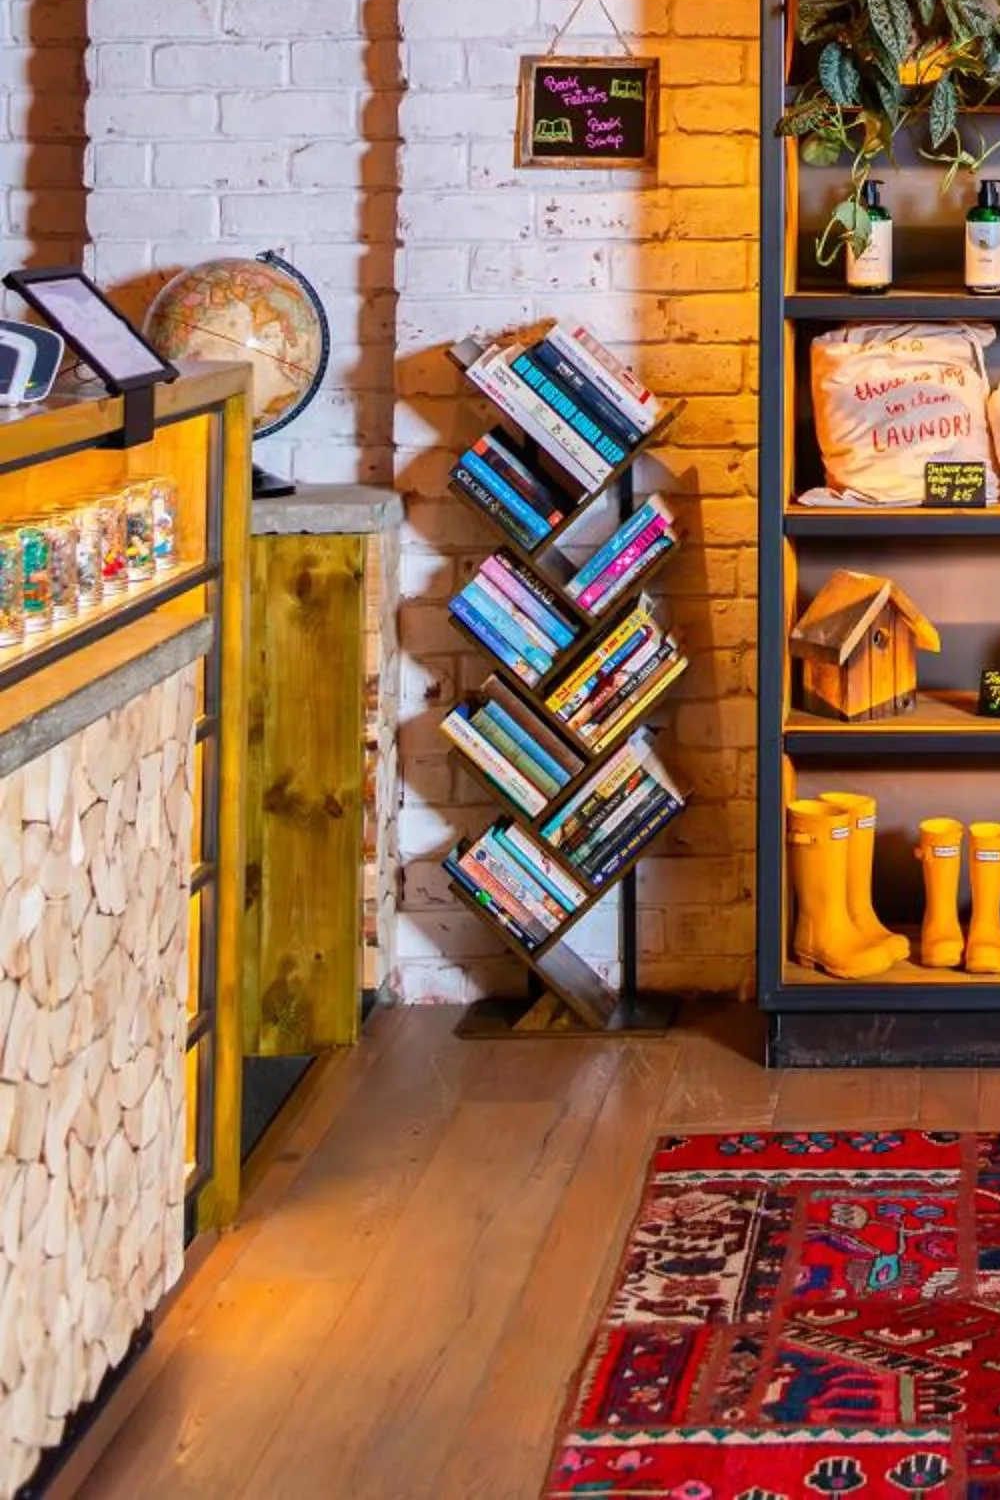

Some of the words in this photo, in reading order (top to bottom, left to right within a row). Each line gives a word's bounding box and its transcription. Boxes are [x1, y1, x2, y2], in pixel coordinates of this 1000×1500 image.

[543, 75, 580, 93] Book
[587, 117, 624, 133] Book
[585, 134, 624, 149] Swap
[854, 377, 905, 401] there
[939, 366, 966, 387] joy
[911, 391, 953, 407] clean
[871, 413, 972, 453] LAUNDRY
